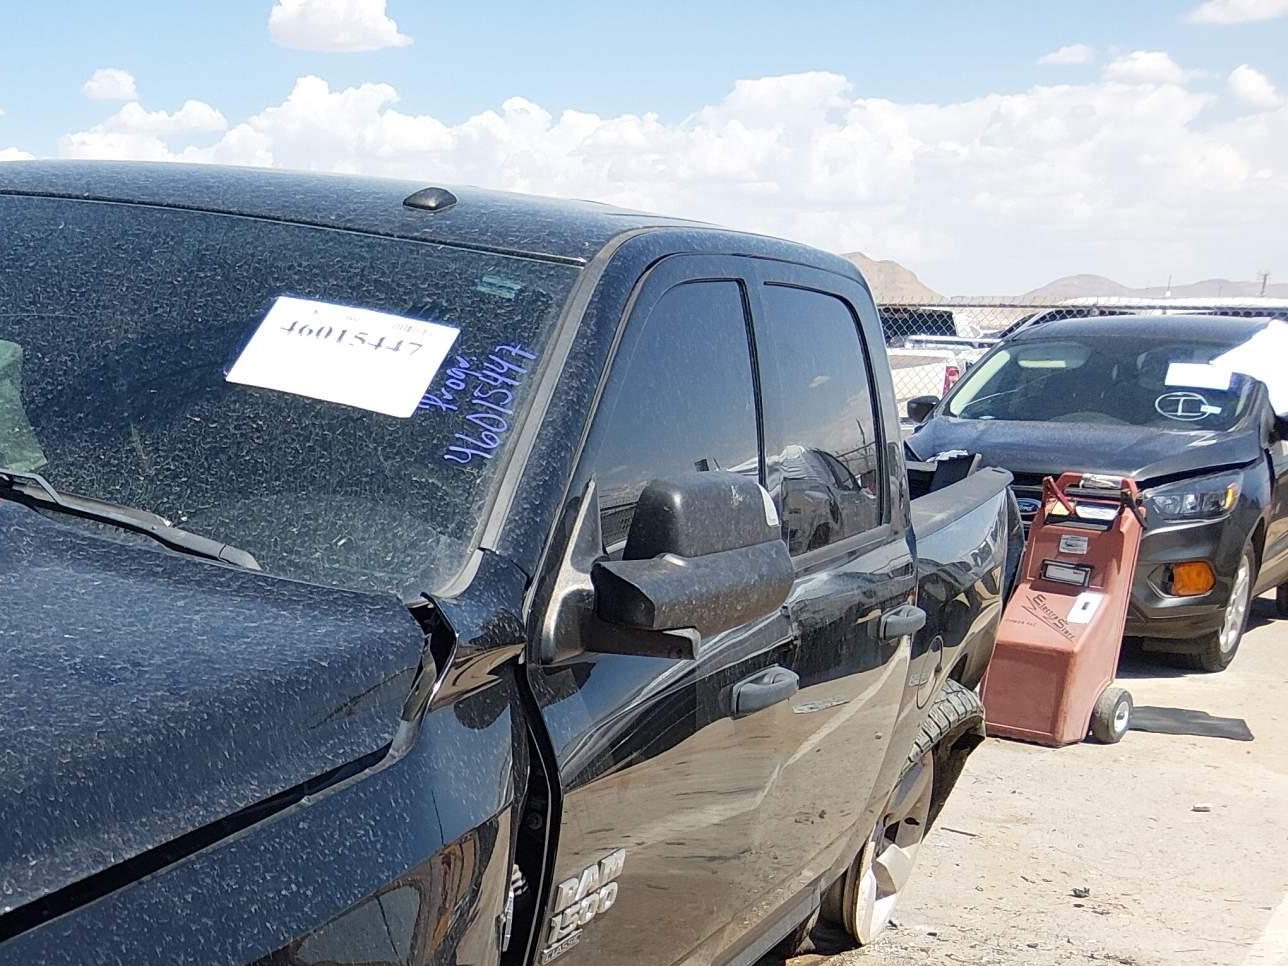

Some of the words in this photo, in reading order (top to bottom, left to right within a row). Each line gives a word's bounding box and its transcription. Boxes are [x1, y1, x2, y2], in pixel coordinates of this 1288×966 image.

[280, 311, 423, 355] 46015447
[443, 343, 537, 464] 46015447
[548, 881, 619, 945] 1500
[553, 848, 626, 914] RAM
